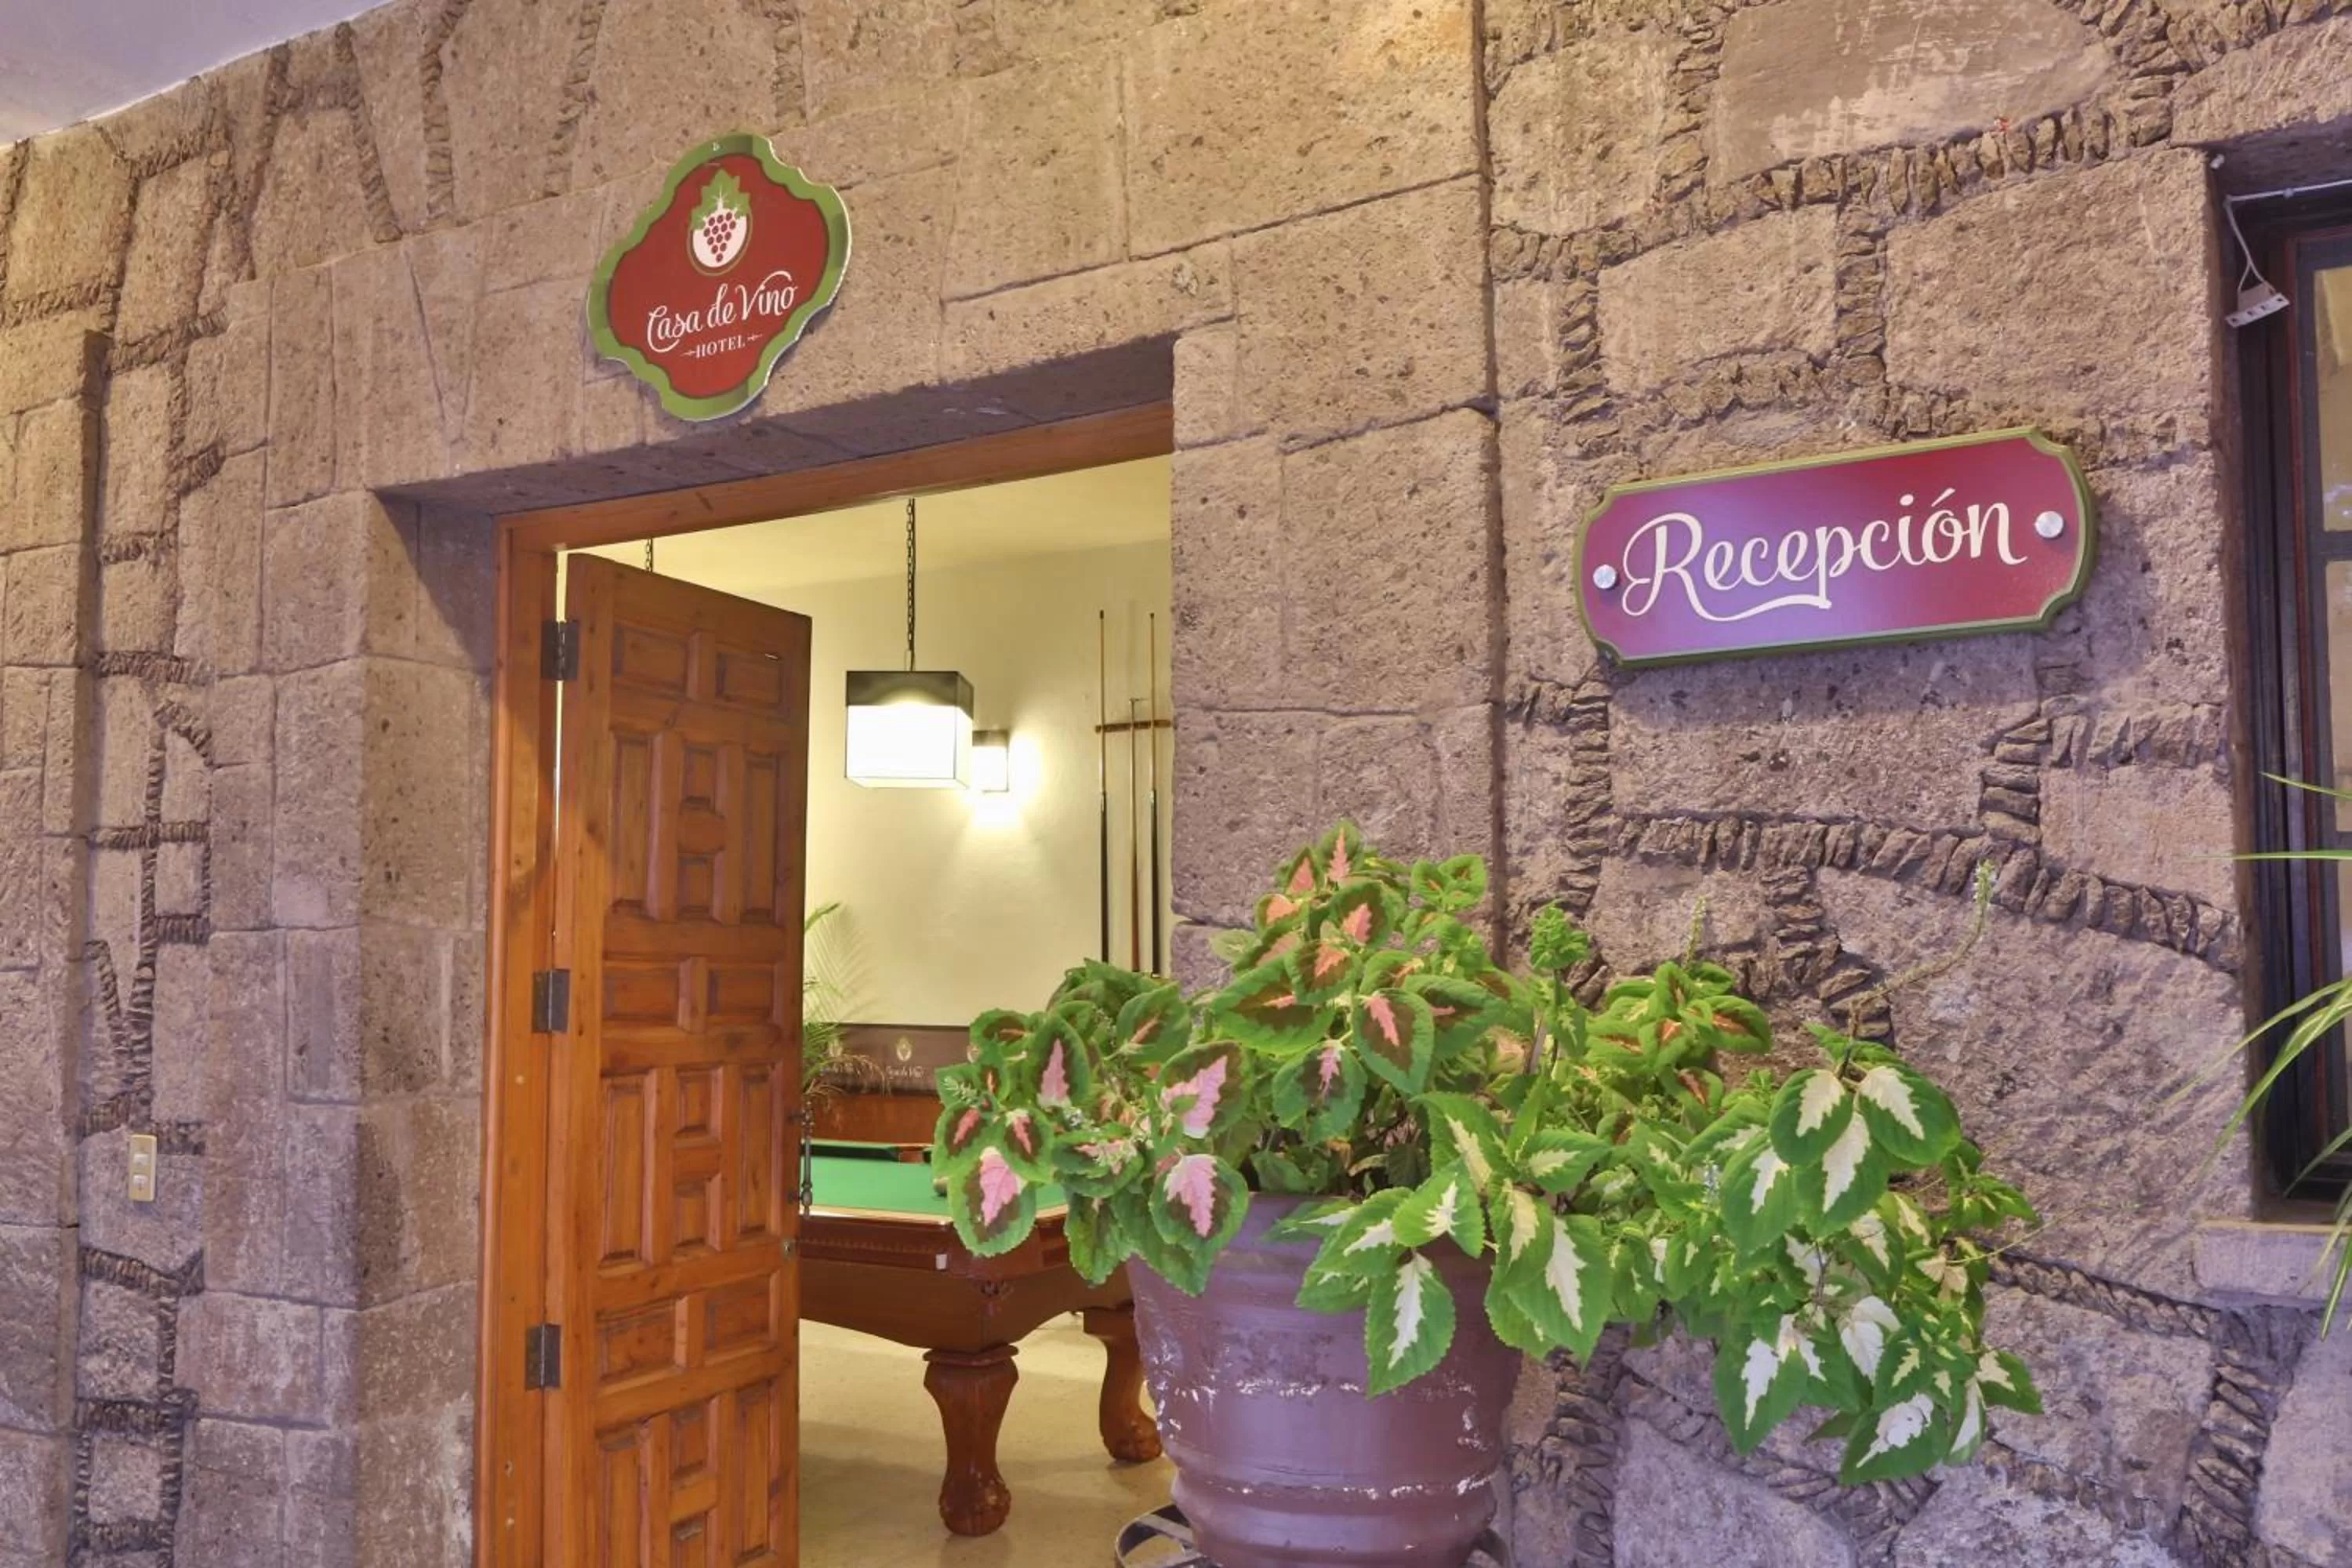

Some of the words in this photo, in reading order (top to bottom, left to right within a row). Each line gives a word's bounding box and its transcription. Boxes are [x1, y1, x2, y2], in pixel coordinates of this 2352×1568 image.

[647, 305, 703, 353] Casa
[707, 283, 737, 328] de
[735, 270, 799, 321] Vino
[695, 335, 746, 358] HOTEL
[1621, 488, 2027, 622] Recepción
